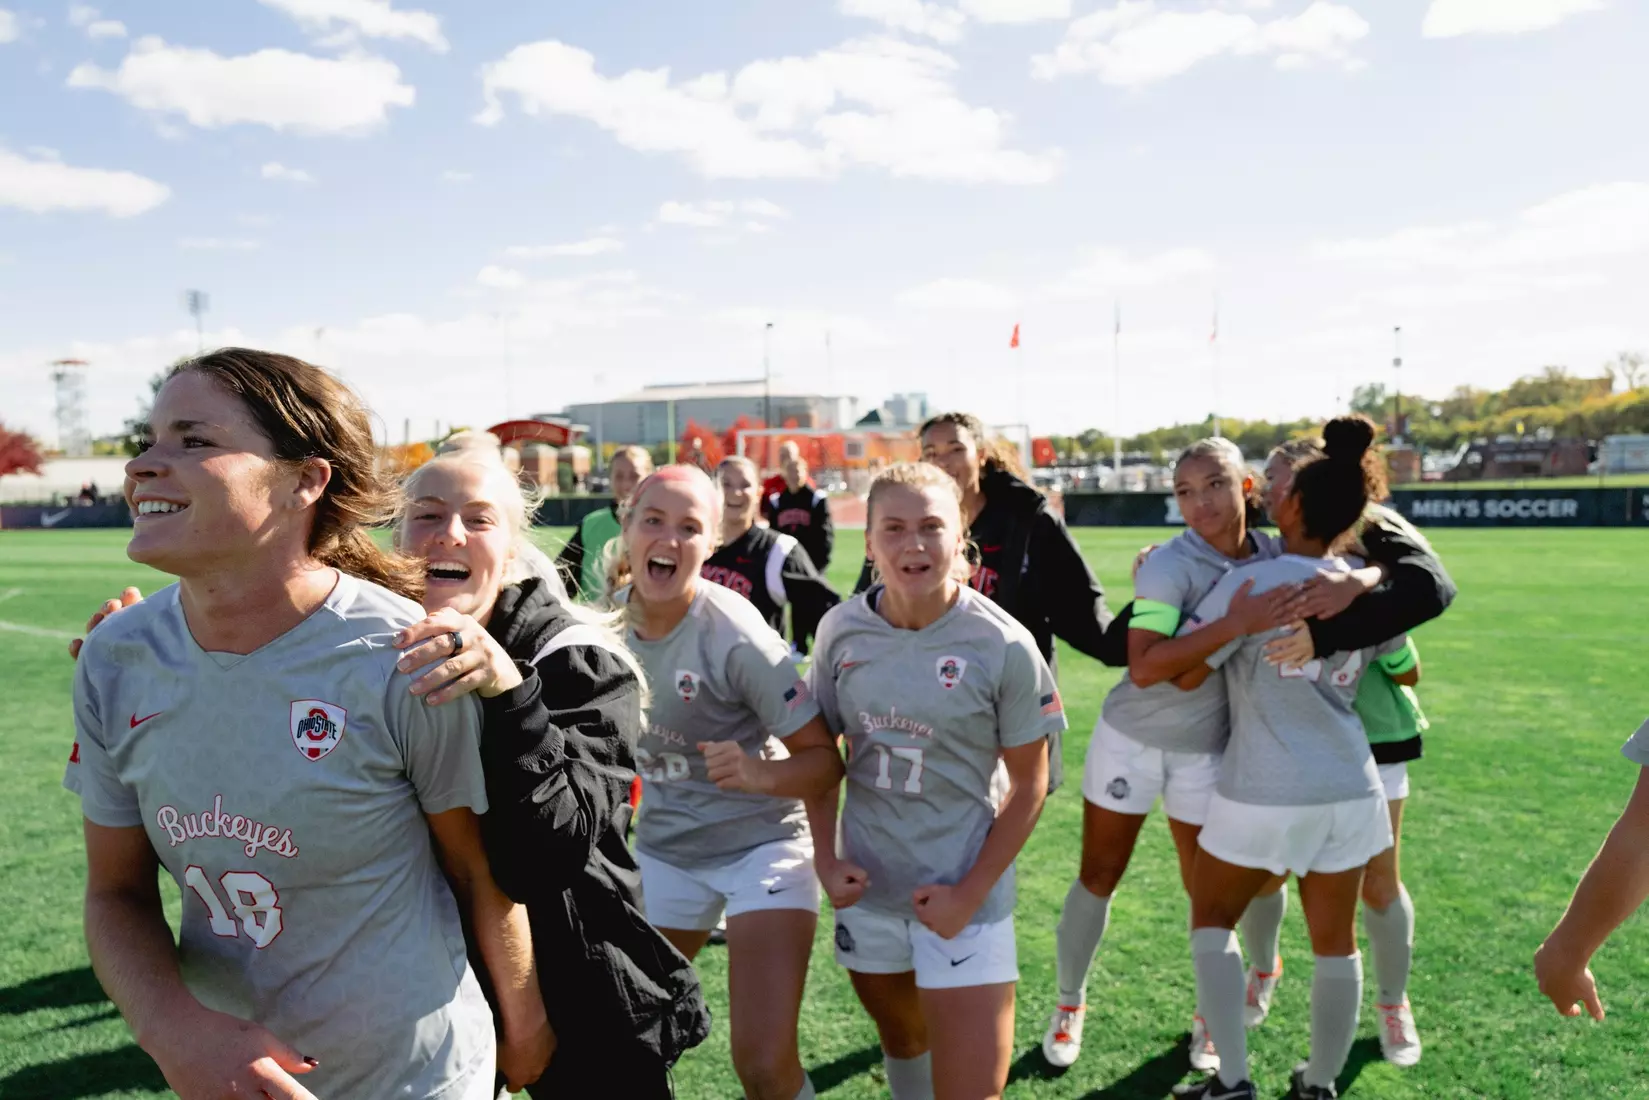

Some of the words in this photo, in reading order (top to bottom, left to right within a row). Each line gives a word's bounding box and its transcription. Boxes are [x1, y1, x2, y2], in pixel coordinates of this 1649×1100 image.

[1412, 499, 1480, 518] MEN'S
[1484, 499, 1578, 518] SOCCER
[873, 744, 924, 794] 17
[157, 794, 299, 858] Buckeyes
[184, 864, 284, 950] 18
